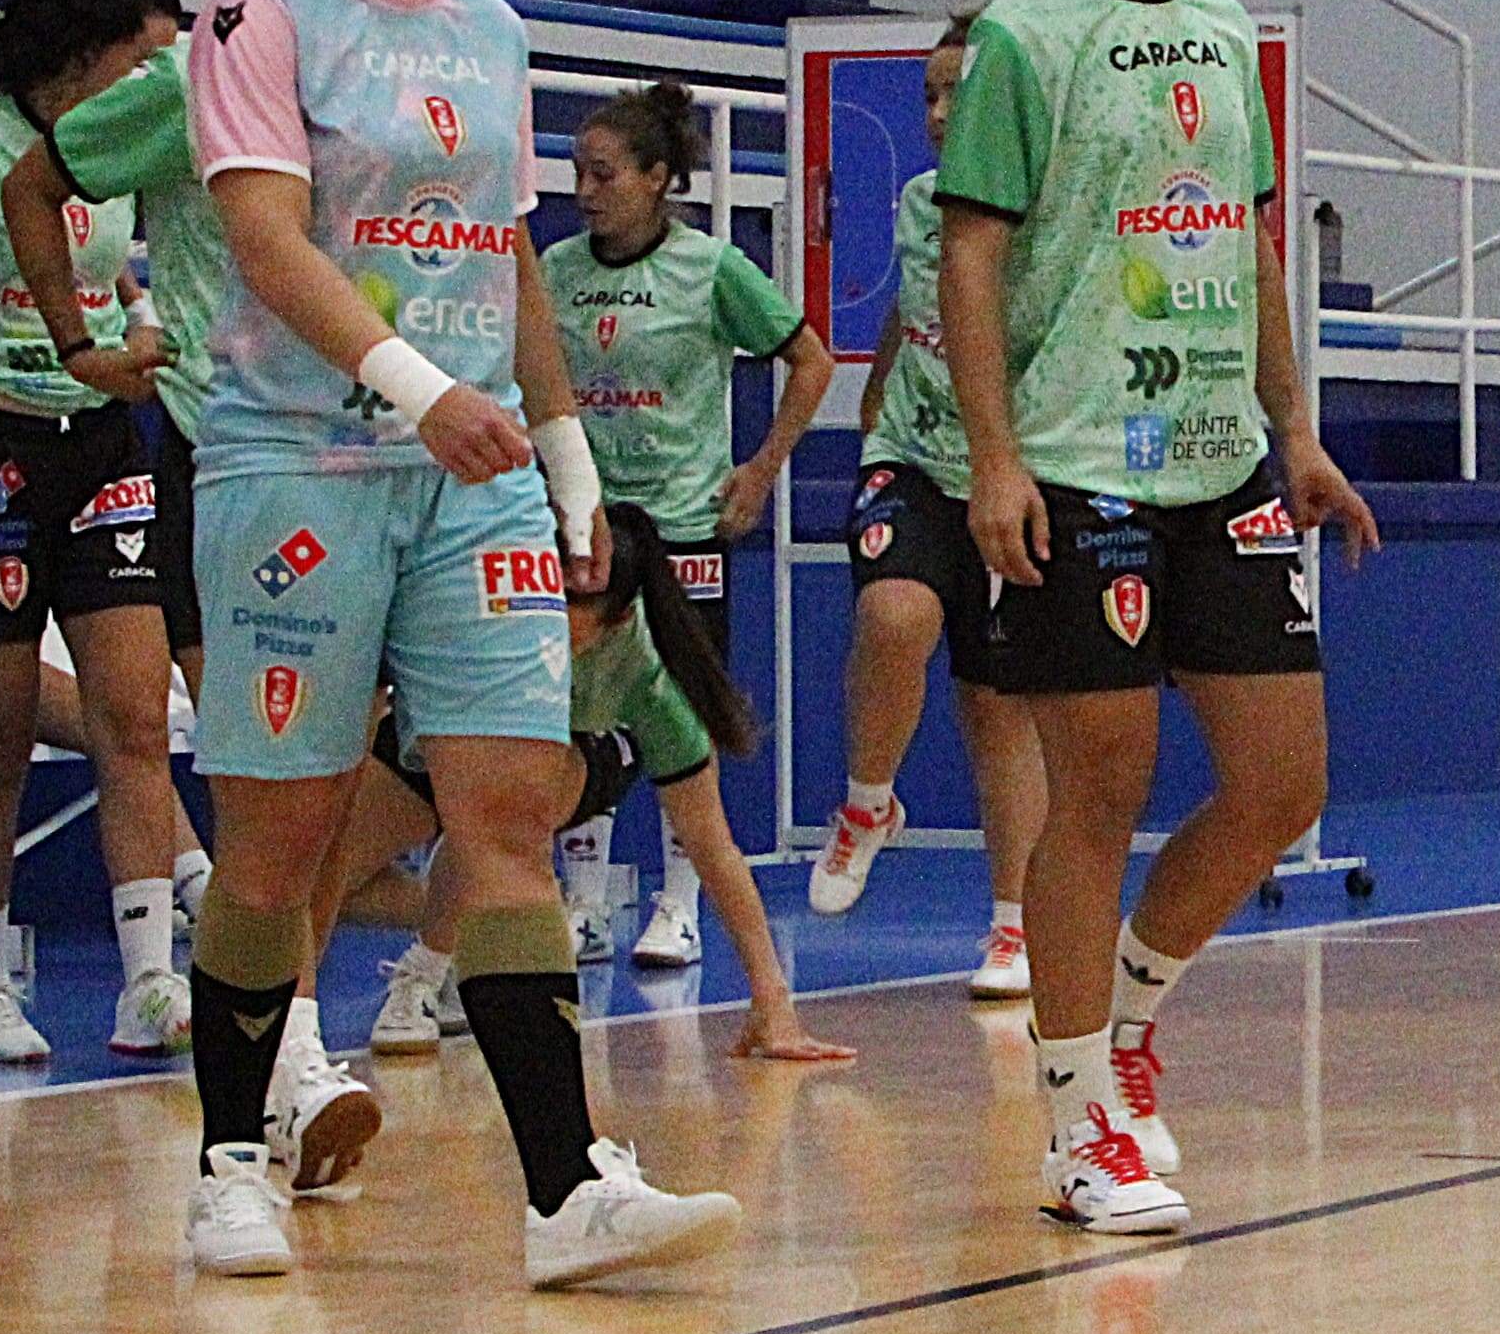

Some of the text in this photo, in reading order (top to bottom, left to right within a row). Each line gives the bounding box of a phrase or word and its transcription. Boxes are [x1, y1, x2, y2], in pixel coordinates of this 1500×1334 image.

[364, 49, 489, 85] CARACAL
[1109, 38, 1228, 72] CARACAL
[572, 290, 656, 308] CARACAL
[404, 297, 502, 339] ence
[1174, 415, 1238, 437] XUNTA
